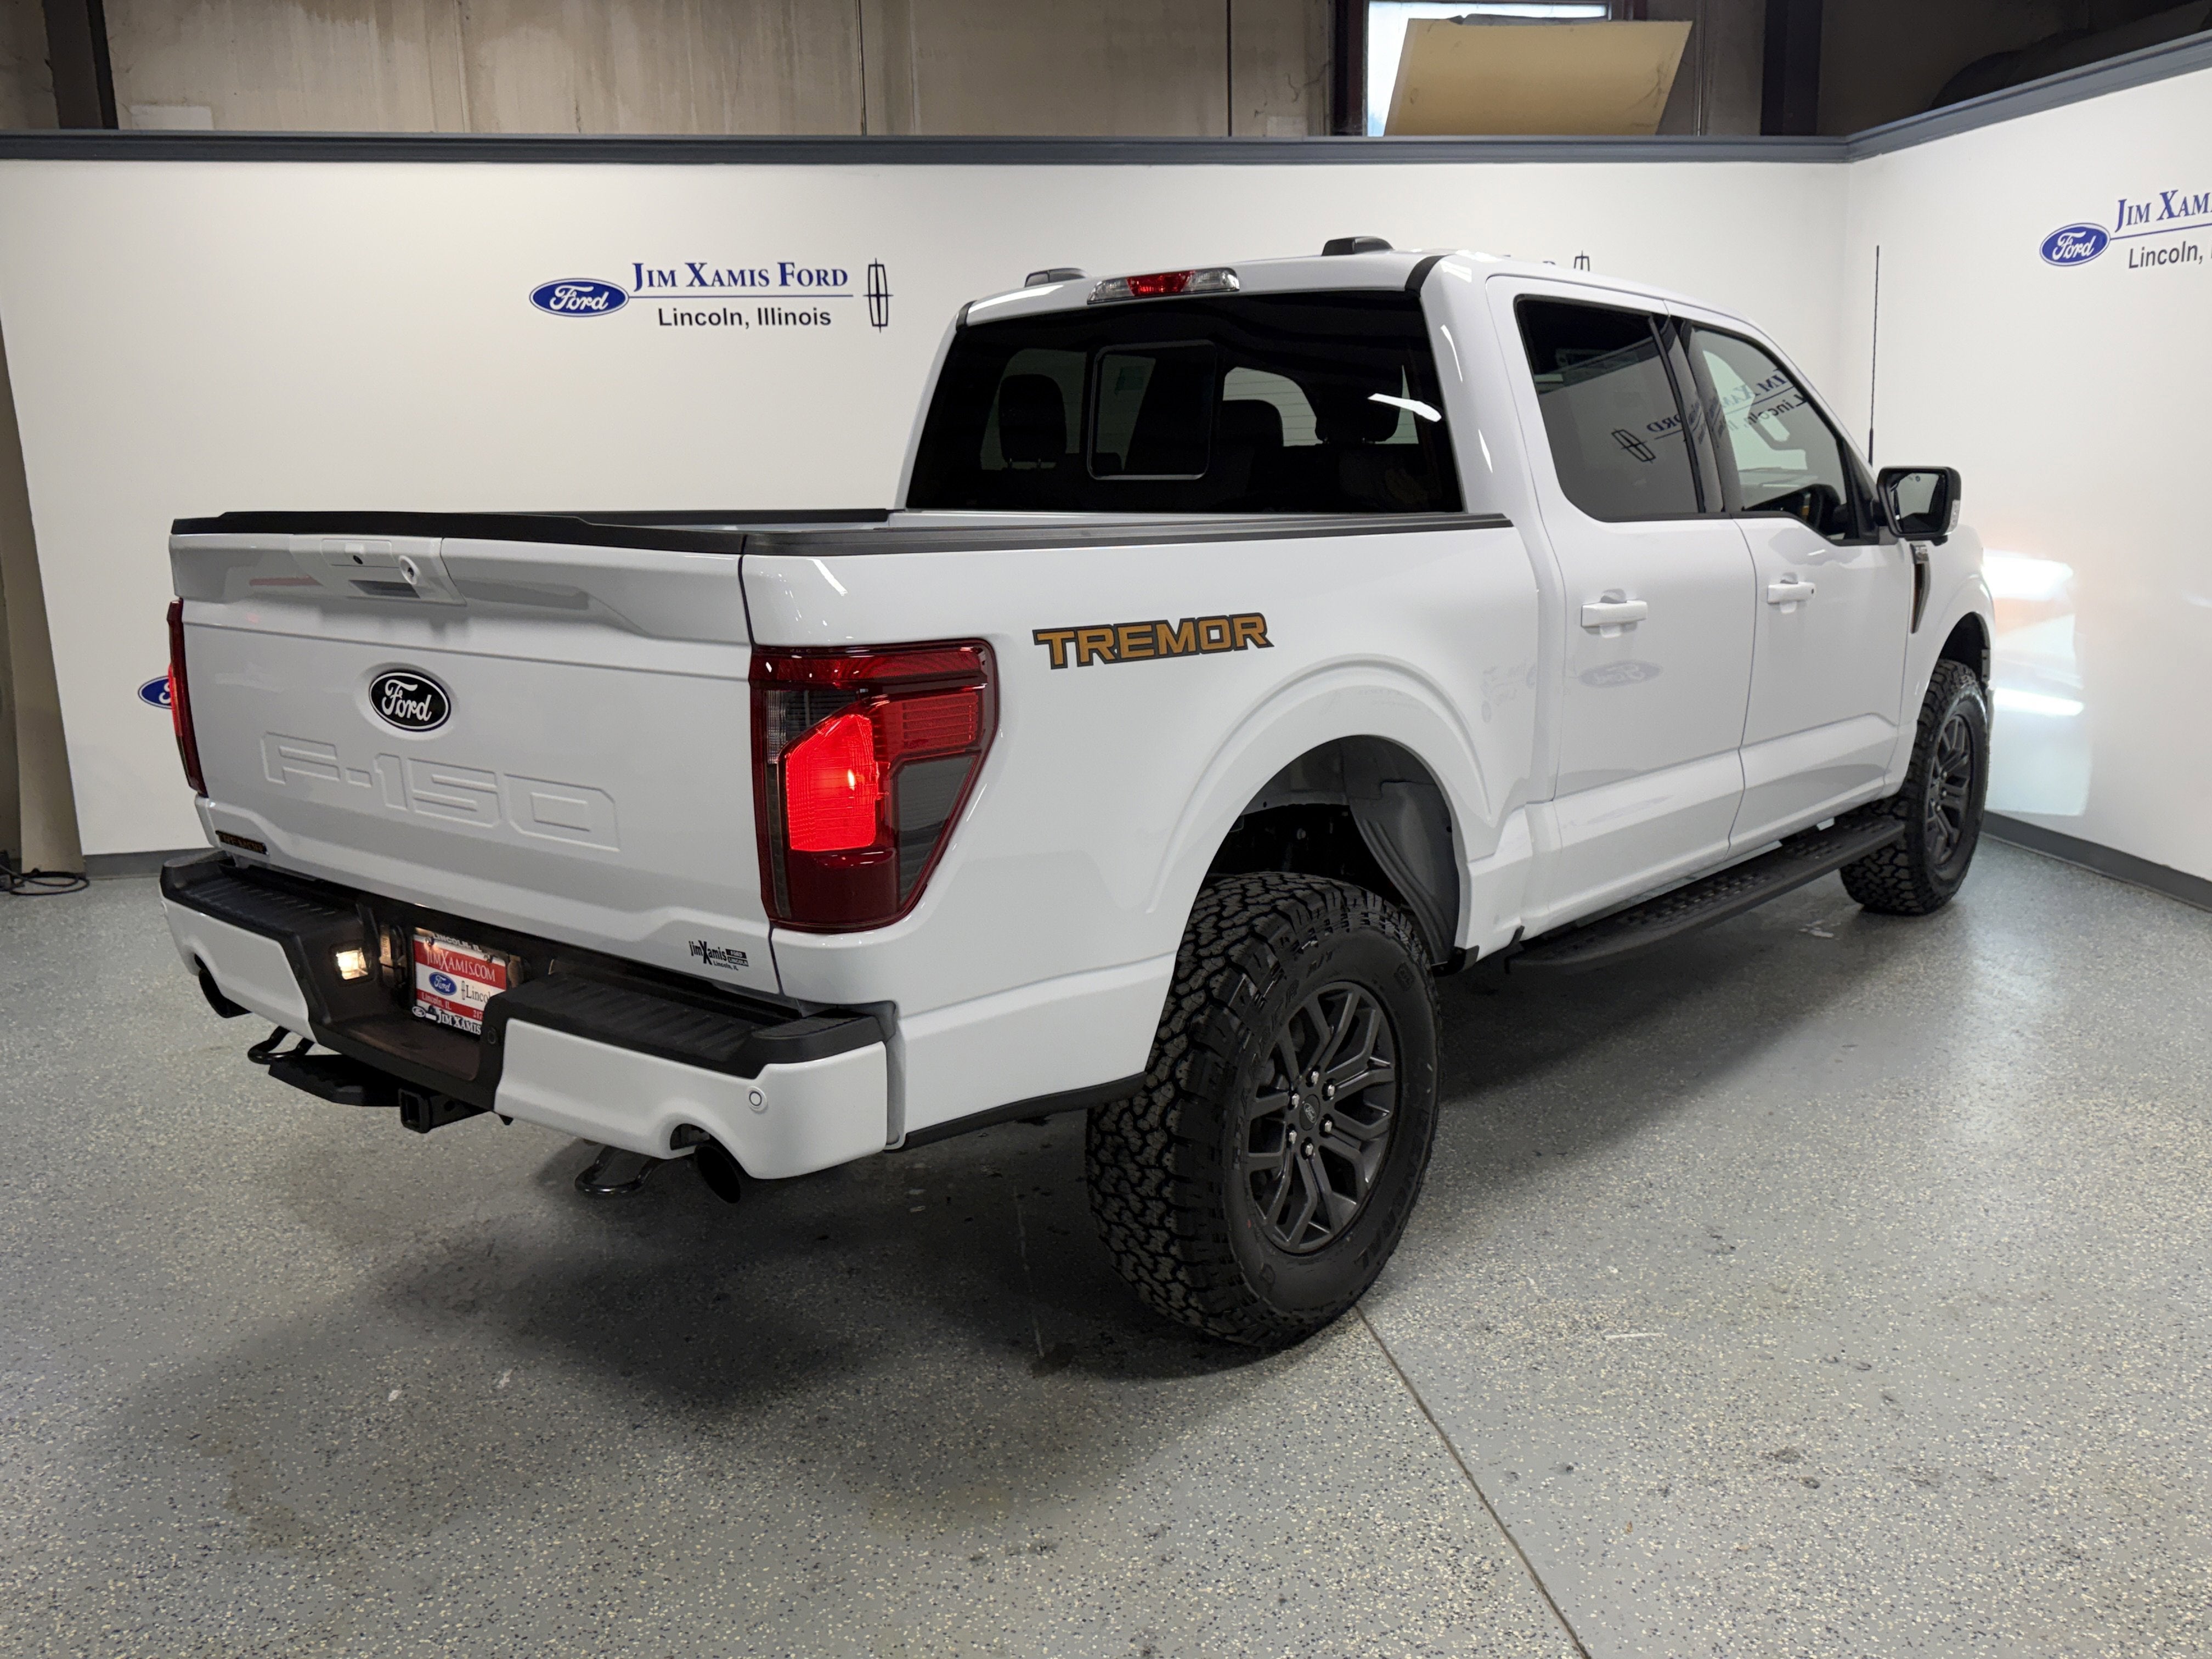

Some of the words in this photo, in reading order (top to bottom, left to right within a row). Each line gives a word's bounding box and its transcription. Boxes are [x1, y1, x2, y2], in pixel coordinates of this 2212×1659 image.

[2114, 199, 2152, 233] JIM
[2052, 231, 2097, 260] Ford
[2128, 241, 2204, 269] Lincoln,
[632, 262, 676, 292] JIM
[684, 262, 770, 288] XAMIS
[777, 262, 848, 287] FORD
[549, 285, 608, 311] Ford
[658, 307, 750, 329] Lincoln,
[757, 307, 832, 326] Illinois
[1032, 612, 1274, 669] TREMOR
[381, 679, 432, 721] Ford
[260, 731, 620, 853] F-150
[427, 949, 495, 981] JIMXAMIS.COM
[433, 974, 451, 992] Ford
[466, 985, 491, 1004] Lincol
[438, 1009, 453, 1025] JIM
[454, 1016, 481, 1035] XAMIS
